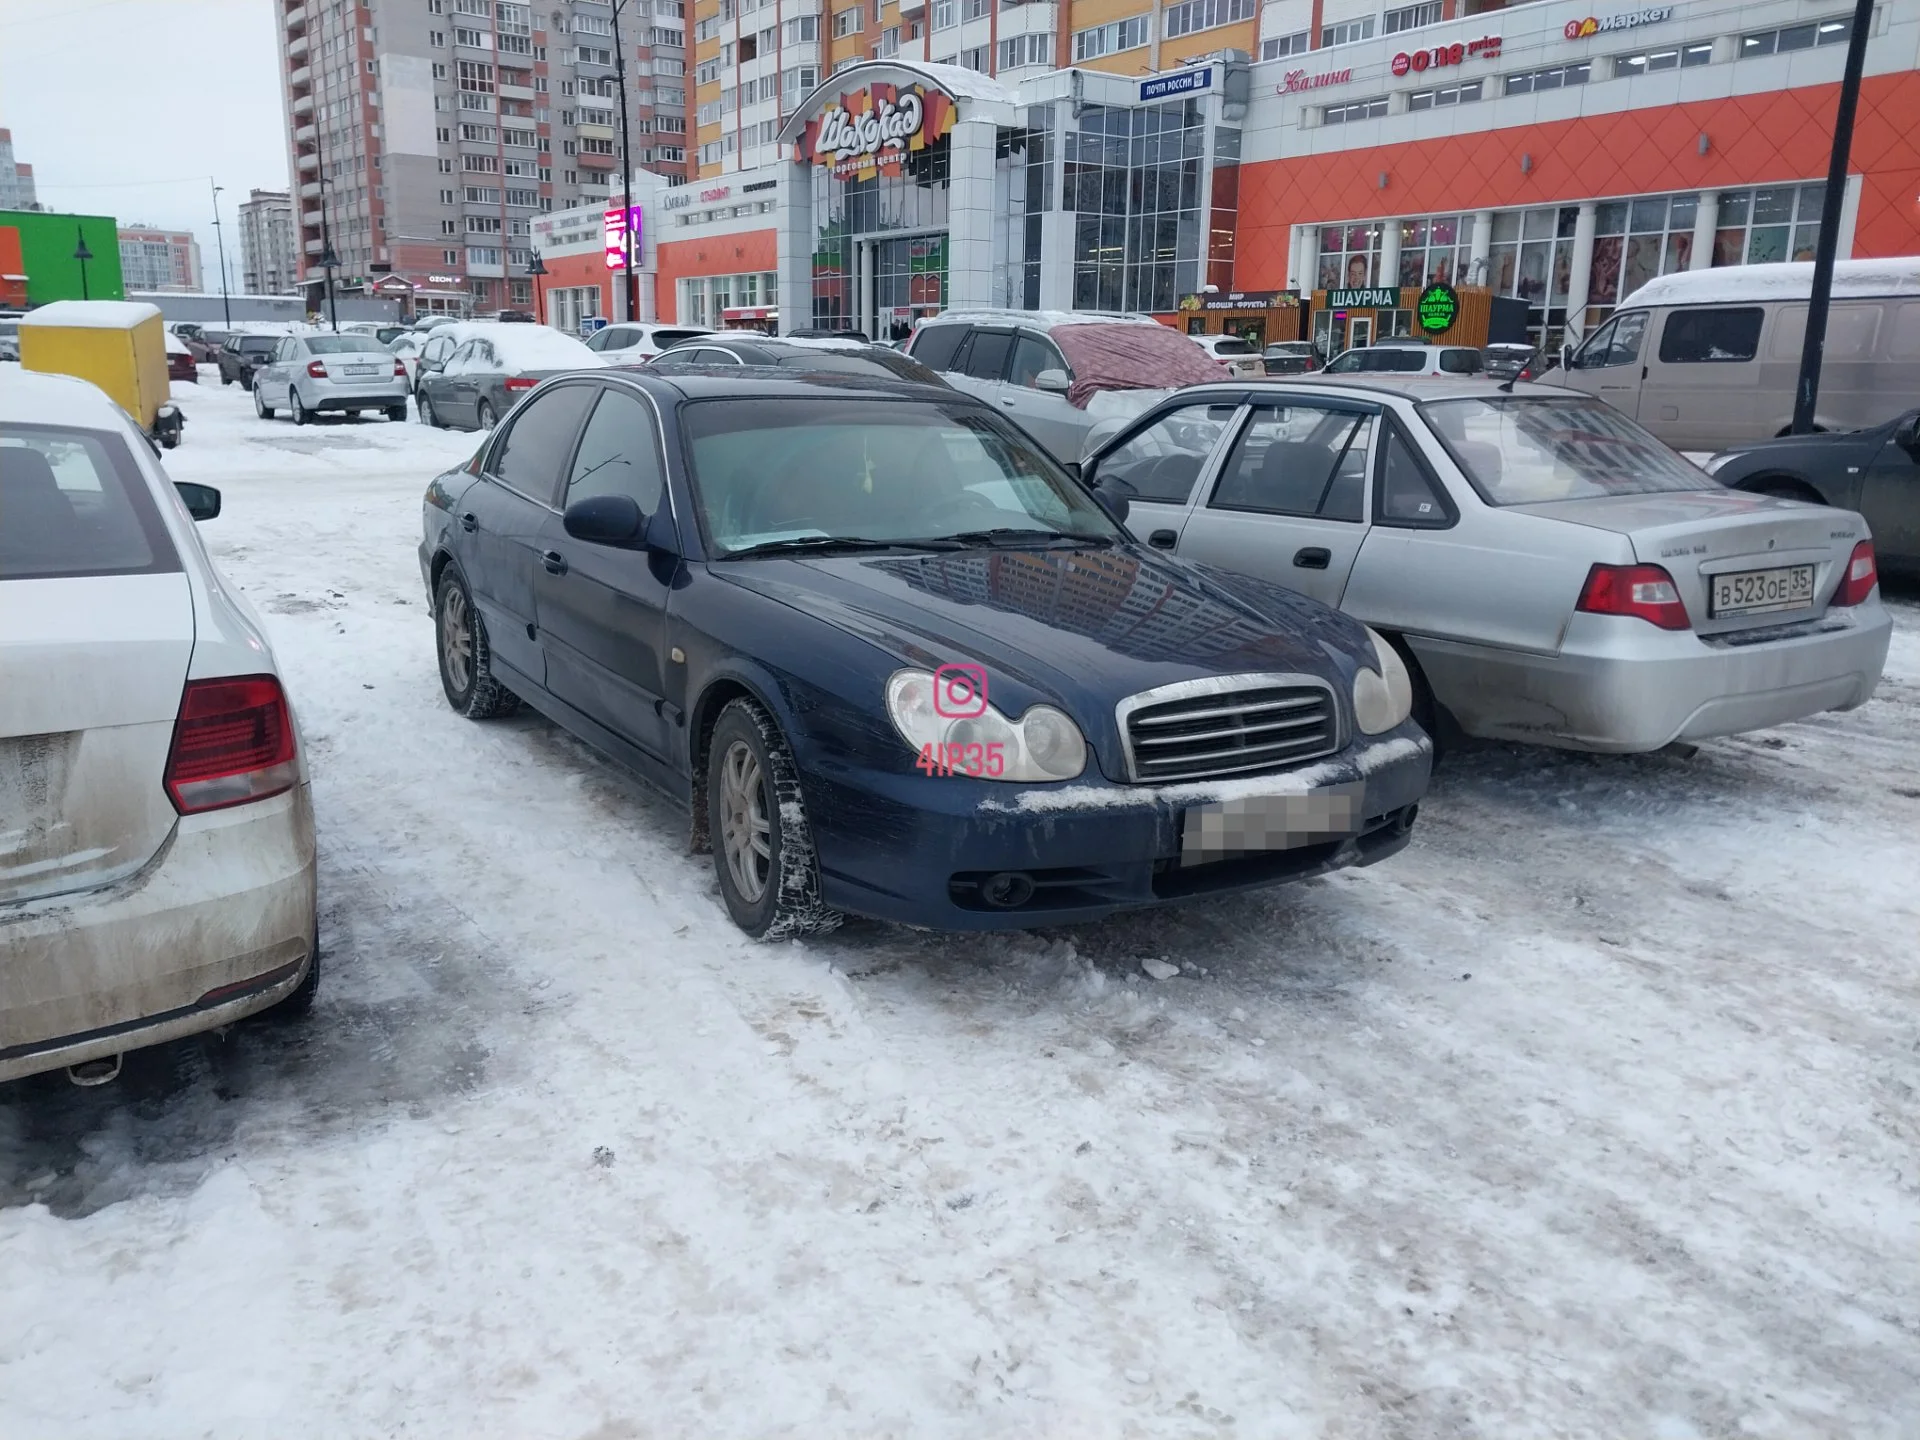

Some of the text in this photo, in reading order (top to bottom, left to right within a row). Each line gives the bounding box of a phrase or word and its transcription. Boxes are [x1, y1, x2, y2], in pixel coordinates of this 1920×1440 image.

[1598, 7, 1673, 31] Маркет
[1146, 76, 1193, 96] ПОЧТА РОССИИ
[1277, 69, 1351, 94] Калина
[832, 152, 907, 174] торговый центр
[429, 275, 452, 283] OZON
[1237, 300, 1267, 309] ФРУКТЫ
[1332, 290, 1393, 307] ШАУРМА
[1420, 304, 1454, 312] ШАУРМА
[1792, 569, 1808, 590] 35
